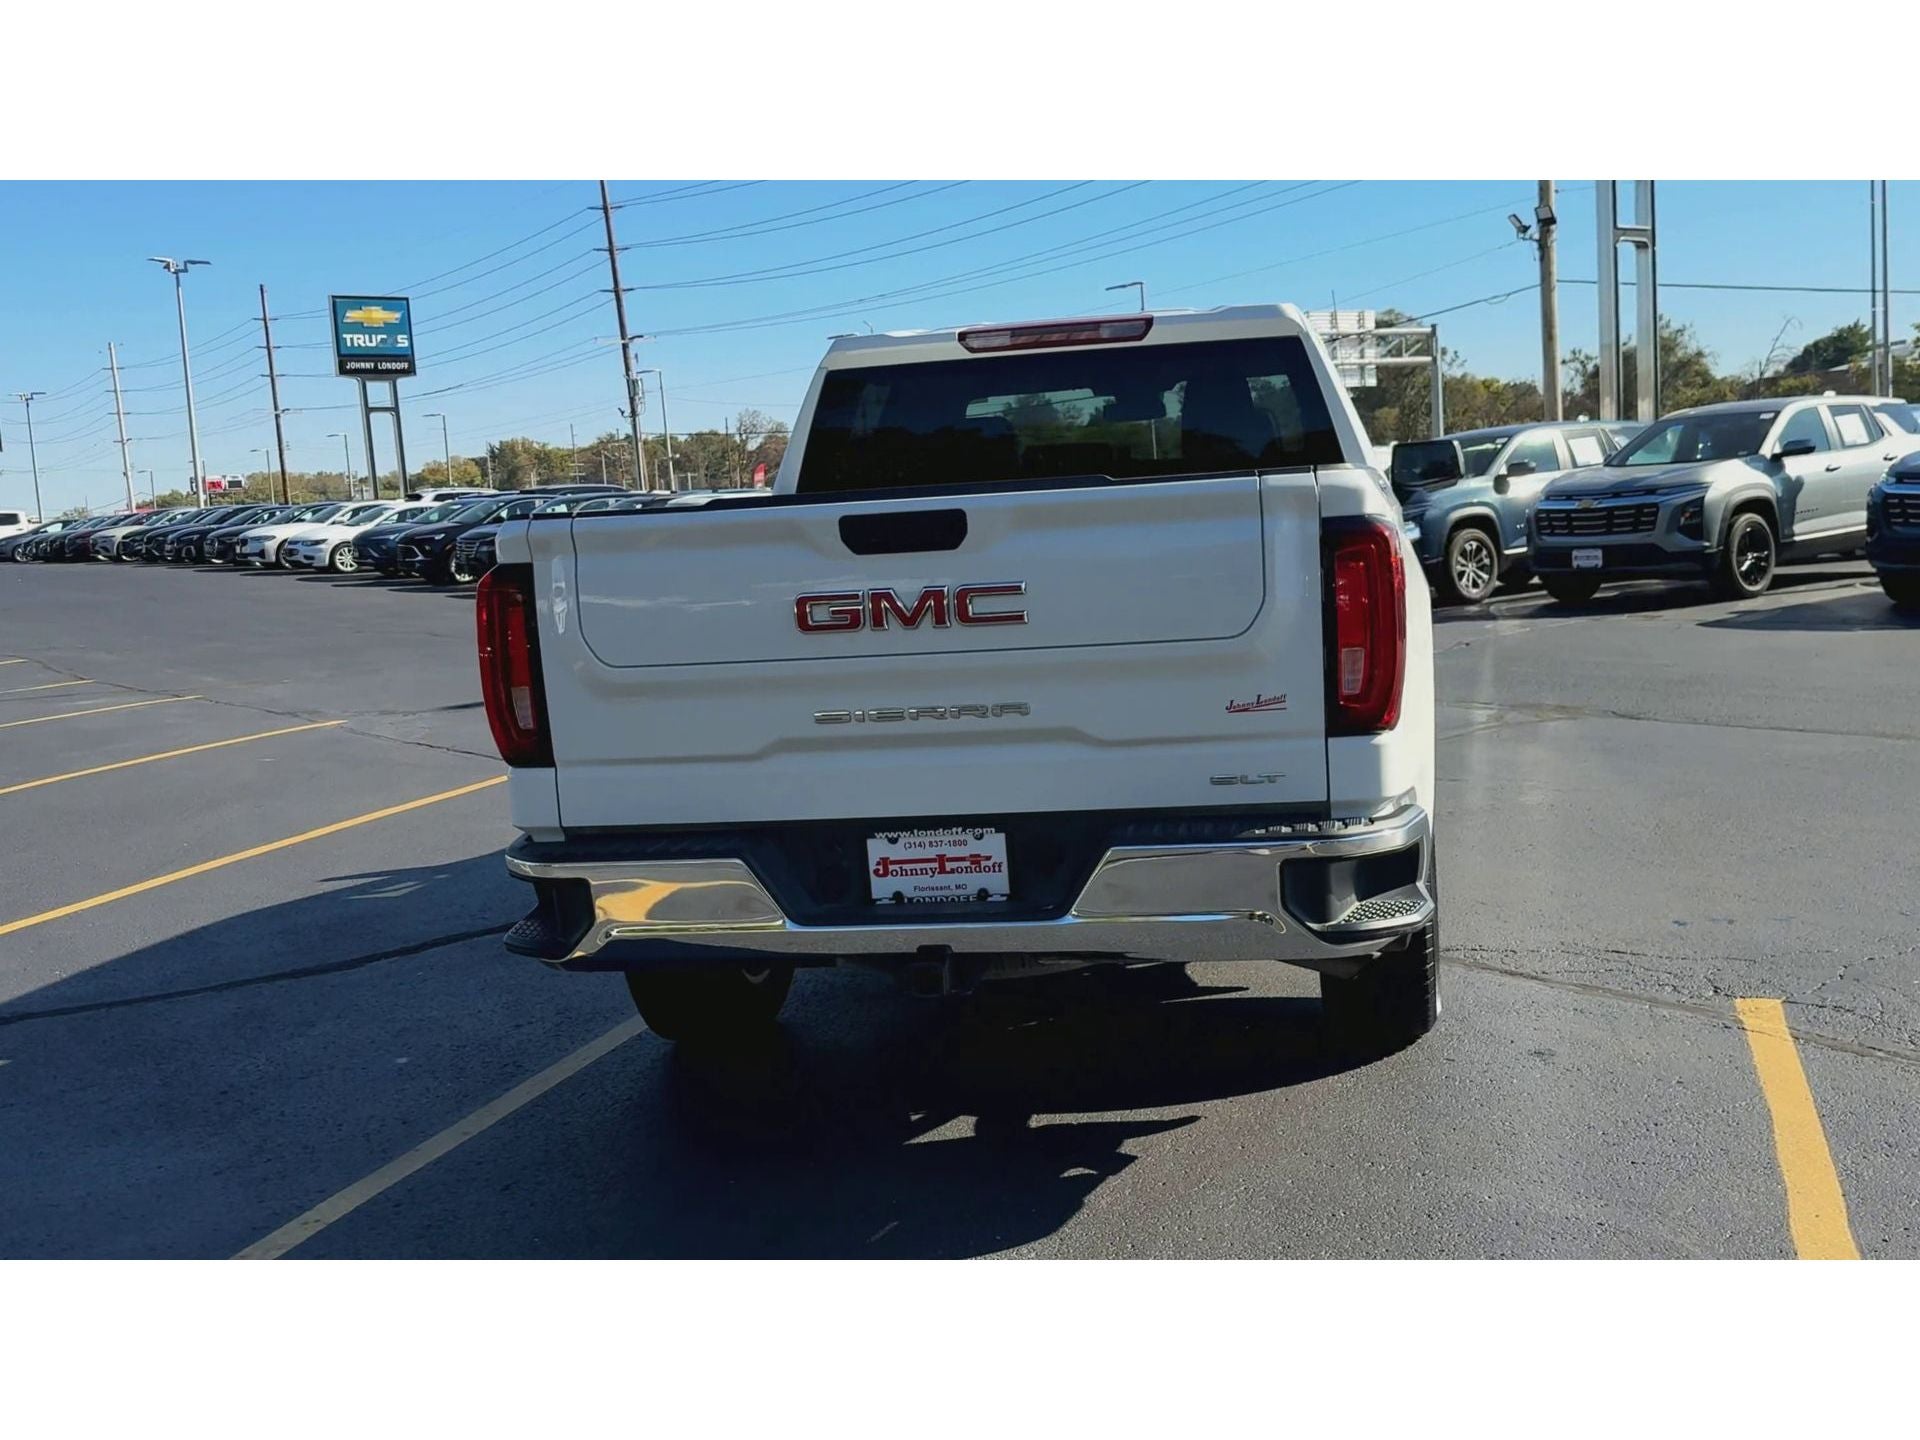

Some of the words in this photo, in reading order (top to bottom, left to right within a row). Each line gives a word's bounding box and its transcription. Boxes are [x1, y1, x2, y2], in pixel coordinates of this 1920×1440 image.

[346, 362, 375, 370] JOHNNY
[378, 361, 409, 370] LONDOFF
[794, 580, 1029, 635] GMC
[813, 702, 1031, 724] SIERRA
[1209, 772, 1287, 786] SLT
[874, 826, 996, 839] www.londoff.com
[903, 840, 926, 850] (314)
[928, 838, 968, 849] 837-1800
[873, 856, 938, 878] Johnny
[935, 853, 1003, 875] Londoff
[913, 884, 954, 893] Florissant,
[954, 883, 968, 891] MO
